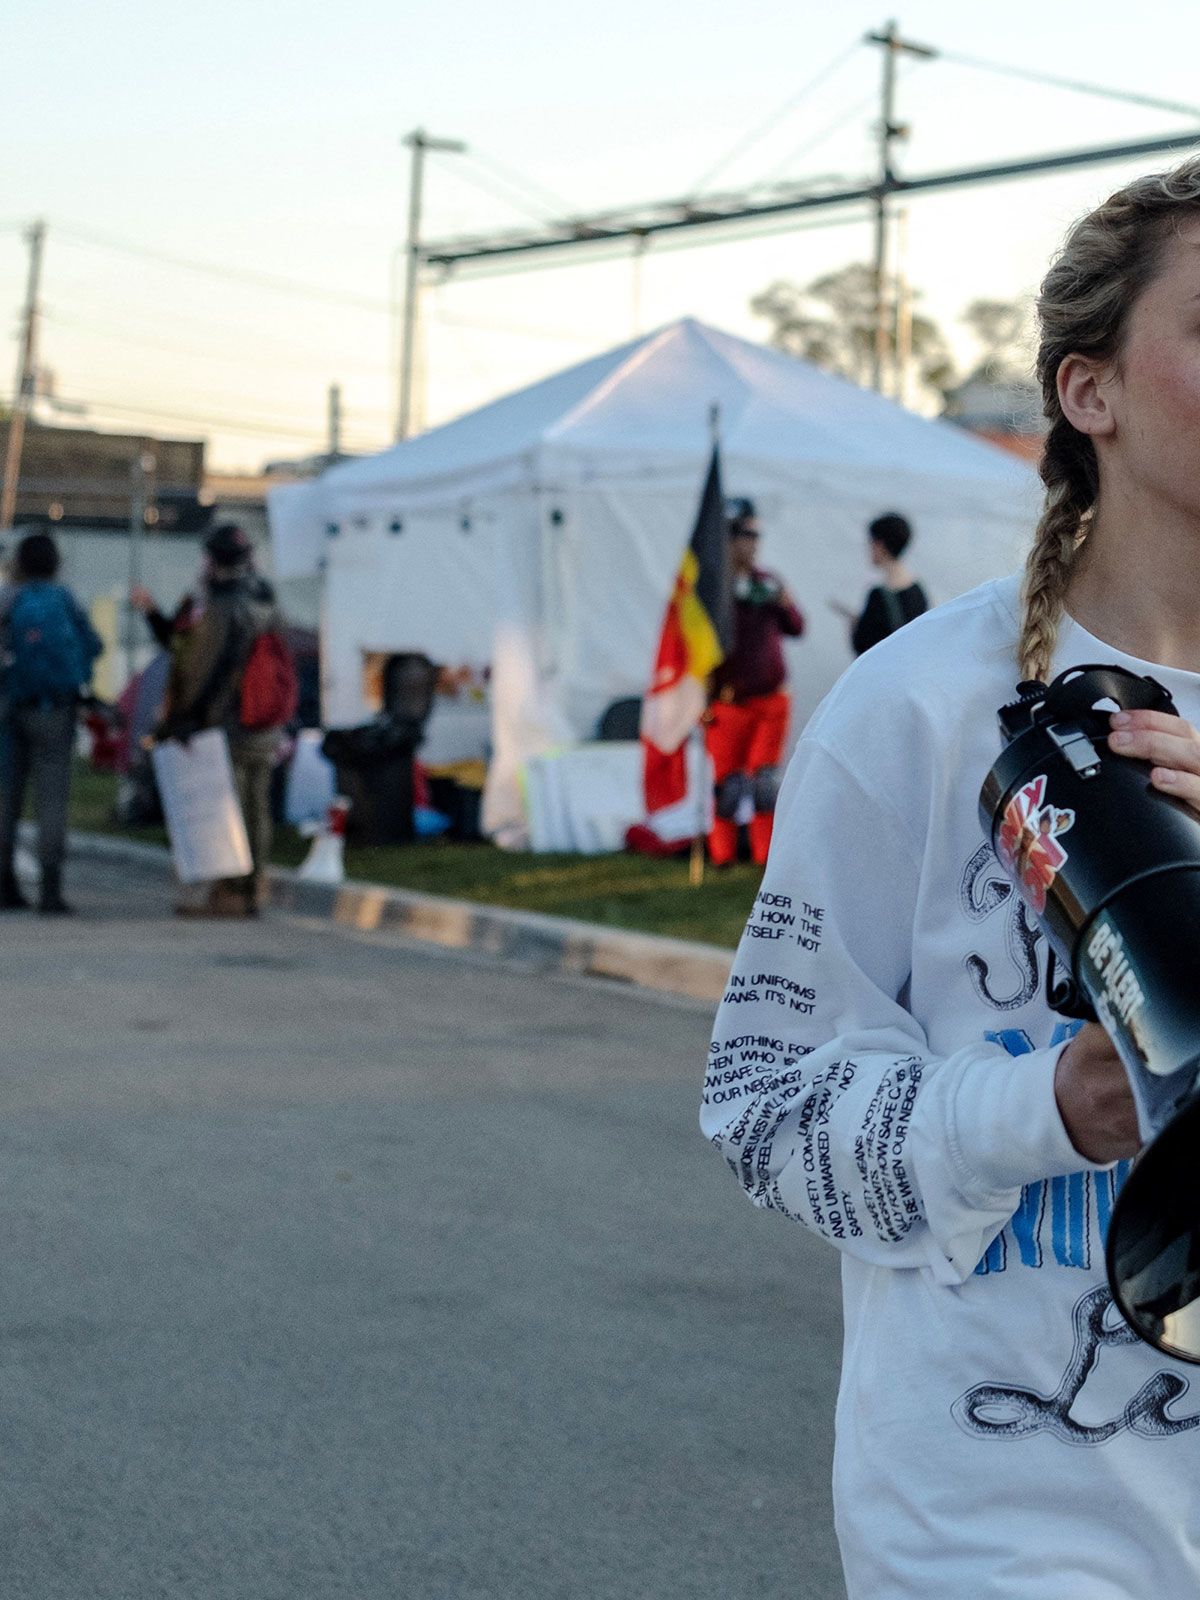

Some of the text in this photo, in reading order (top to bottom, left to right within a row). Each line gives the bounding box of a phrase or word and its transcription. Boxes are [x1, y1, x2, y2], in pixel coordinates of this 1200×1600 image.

[757, 891, 825, 921] NDER THE
[746, 924, 785, 940] TSELF
[797, 934, 822, 953] NOT
[760, 910, 796, 926] HOW
[800, 918, 822, 938] THE
[731, 973, 816, 1000] IN UNIFORMS
[789, 997, 816, 1015] NOT
[724, 1035, 784, 1052] NOTHING
[707, 1054, 734, 1070] HEN
[740, 1050, 776, 1064] WHO
[723, 1064, 753, 1084] SAFE
[838, 1060, 858, 1092] NOT
[712, 1086, 742, 1104] OUR
[878, 1102, 898, 1140] SAFE
[892, 1125, 909, 1156] OUR
[817, 1130, 839, 1208] UNMARKED
[892, 1159, 913, 1198] WHEN
[806, 1176, 826, 1226] SAFETY
[829, 1210, 847, 1240] AND
